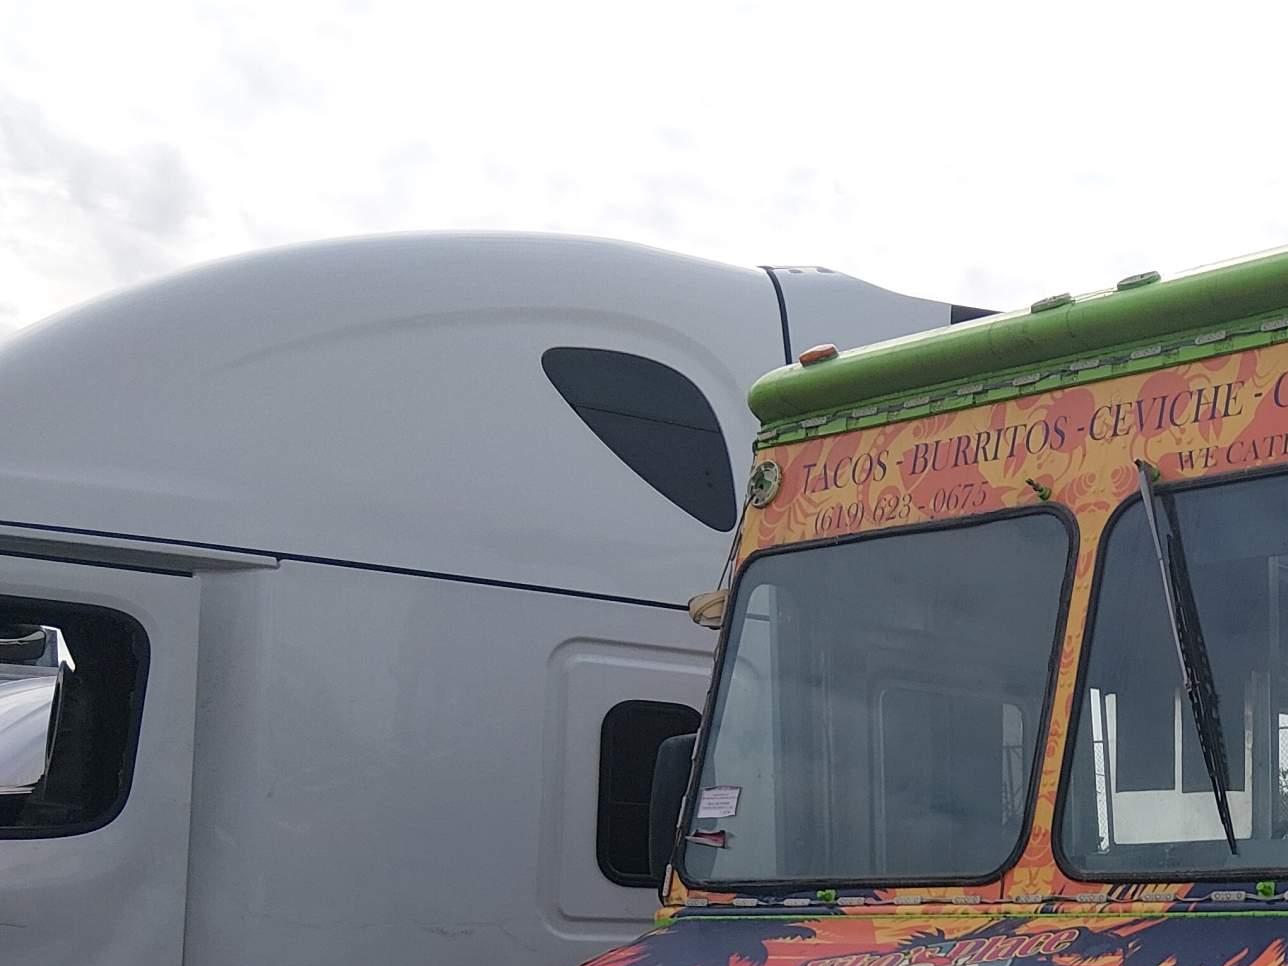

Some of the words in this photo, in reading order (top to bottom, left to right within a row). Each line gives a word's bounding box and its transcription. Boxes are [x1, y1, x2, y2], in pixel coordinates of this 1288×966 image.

[802, 449, 889, 495] TACOS
[910, 415, 1067, 476] BURRITOS
[1088, 379, 1245, 442] CEVICHE
[1176, 446, 1217, 473] WE
[814, 502, 865, 535] (619)
[872, 495, 912, 523] 623
[932, 481, 989, 509] 0675
